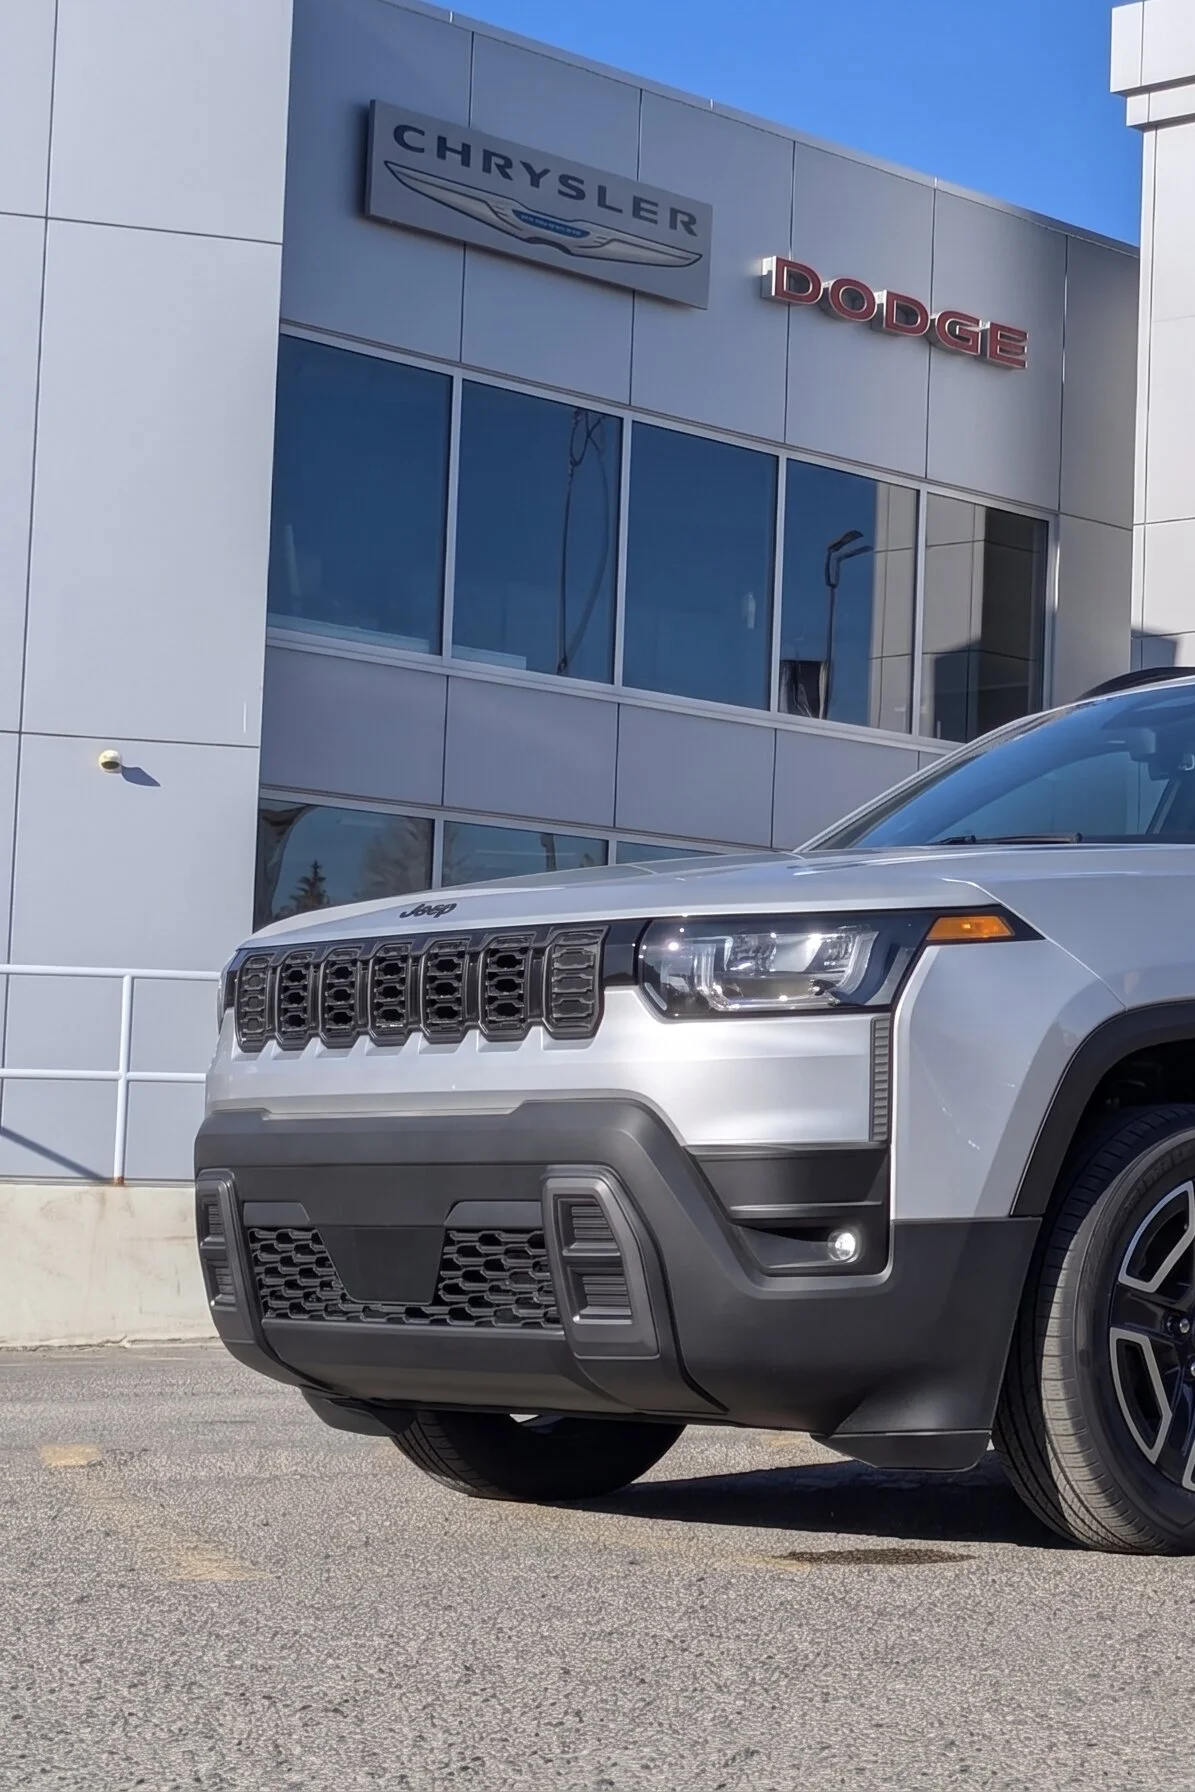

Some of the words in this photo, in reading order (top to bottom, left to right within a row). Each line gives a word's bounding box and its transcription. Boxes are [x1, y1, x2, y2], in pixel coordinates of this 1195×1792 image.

[393, 124, 698, 237] CHRYSLER
[770, 255, 1029, 369] DODGE
[399, 902, 458, 919] Jeep
